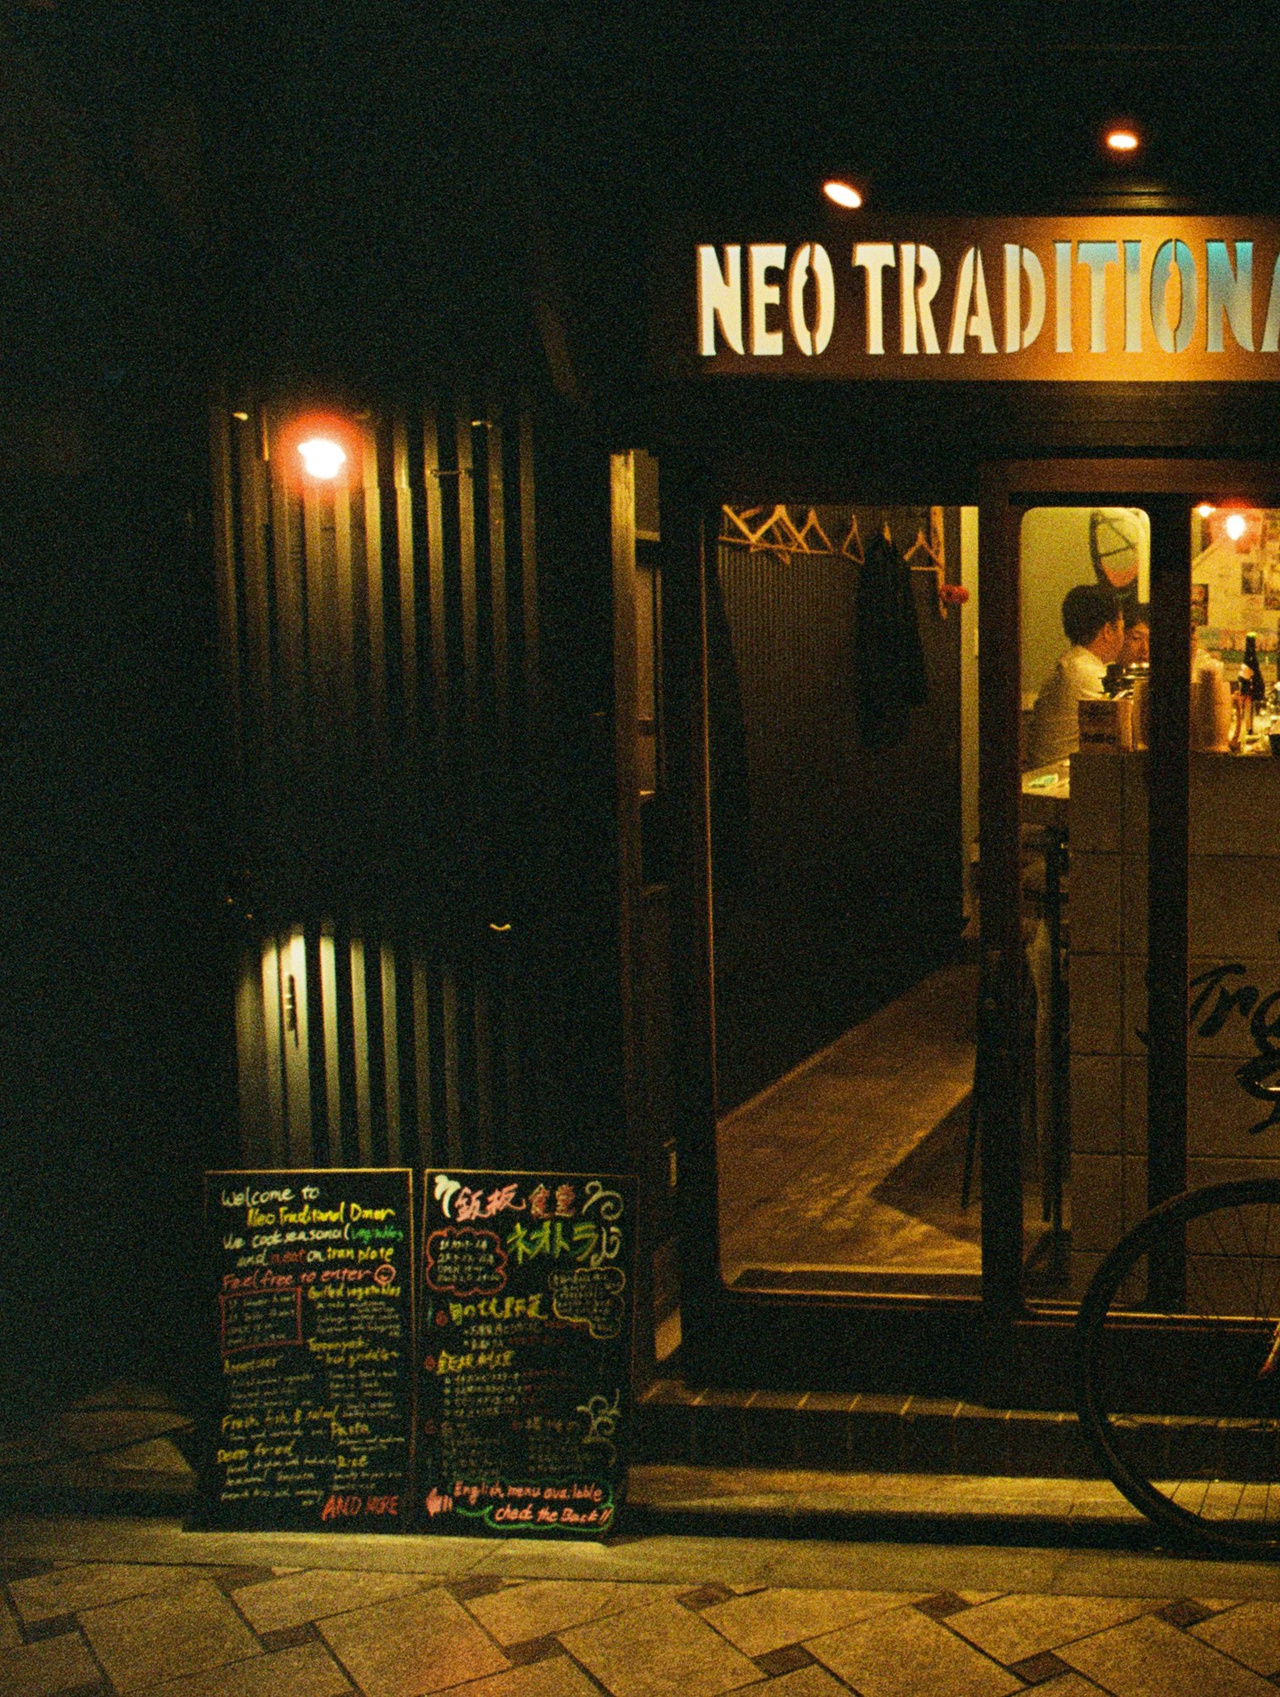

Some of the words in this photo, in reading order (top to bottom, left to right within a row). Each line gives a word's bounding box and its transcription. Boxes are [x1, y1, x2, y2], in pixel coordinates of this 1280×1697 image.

[696, 243, 836, 357] NEO
[220, 1186, 295, 1207] Welcome
[301, 1185, 320, 1200] to
[321, 1494, 362, 1522] AND
[365, 1495, 399, 1516] MORE
